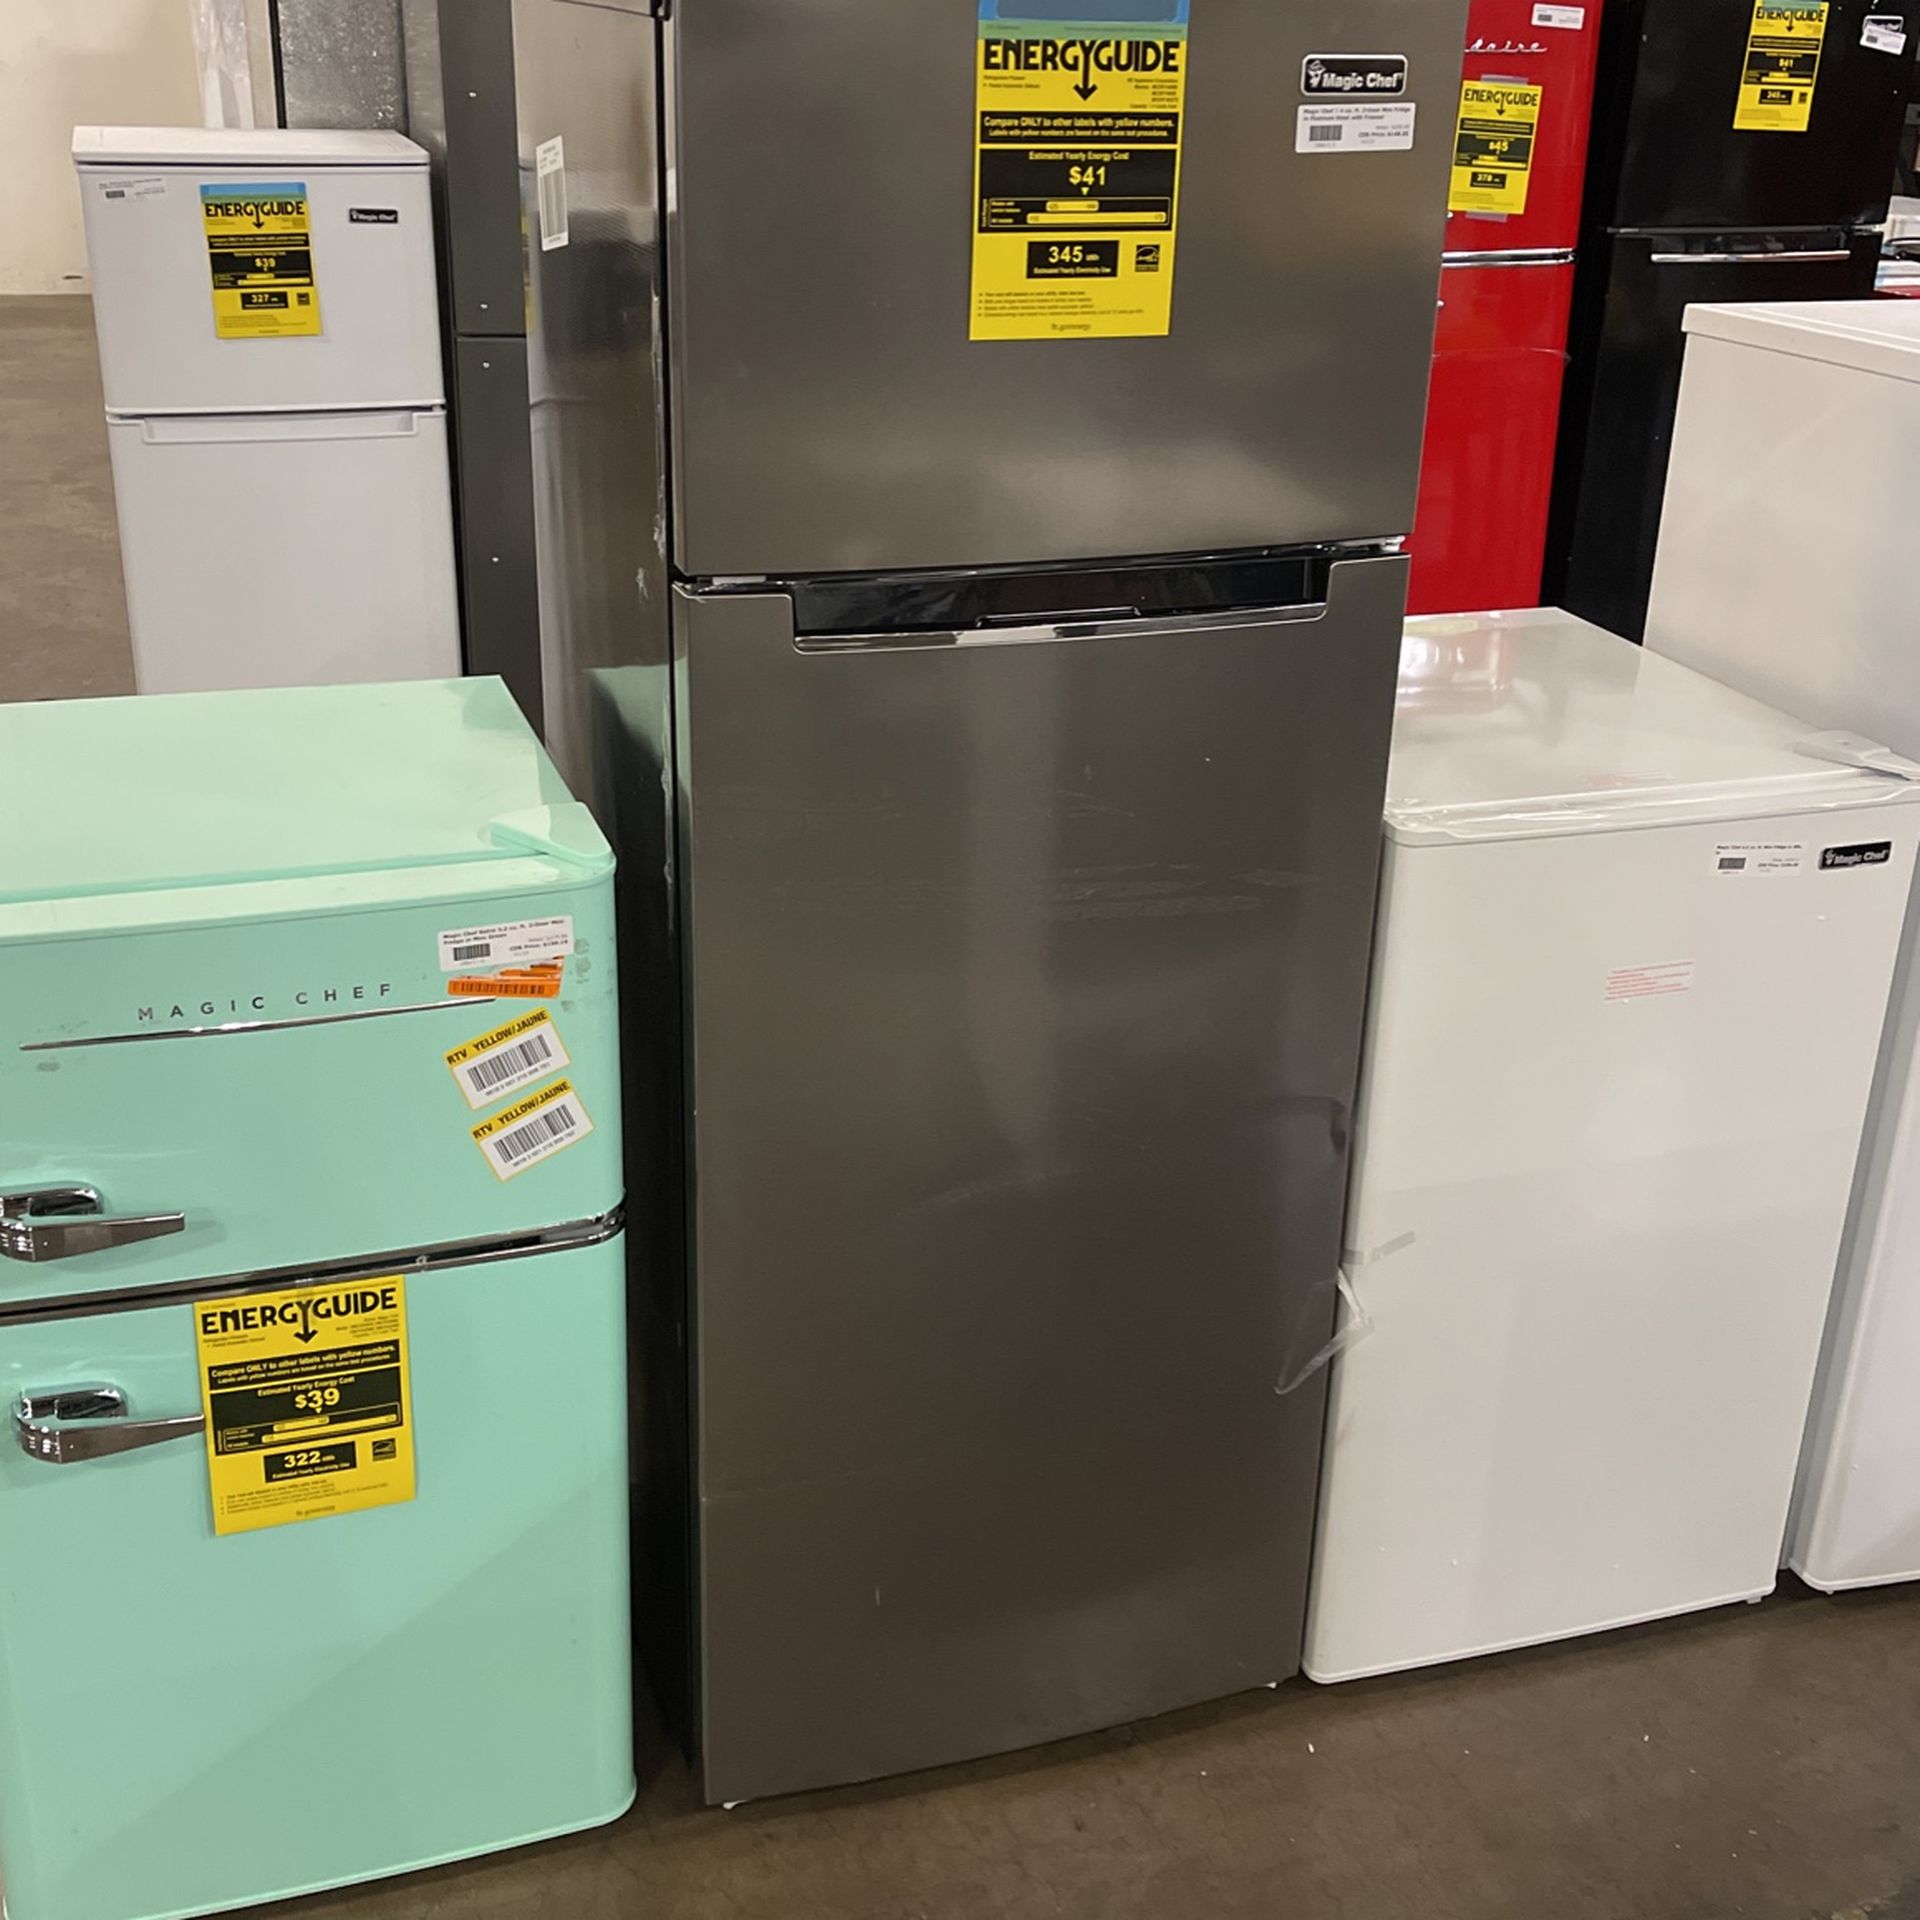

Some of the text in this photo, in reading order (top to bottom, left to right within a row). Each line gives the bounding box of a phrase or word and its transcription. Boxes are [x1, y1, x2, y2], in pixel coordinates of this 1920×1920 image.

[983, 38, 1180, 72] ENERGYGUIDE
[1322, 72, 1400, 91] Magic Chef
[1463, 88, 1539, 107] ENERGYGUIDE
[984, 116, 1175, 128] Compare ONLY to other labels with yellow numbers.
[1029, 152, 1130, 161] Estimated Yearly Energy Cost
[1068, 165, 1106, 186] $41
[205, 201, 305, 217] ENERGYGUIDE
[1048, 246, 1083, 263] 345
[1834, 851, 1886, 866] Magic Chef
[138, 983, 390, 1021] MAGIC CHEF
[446, 1011, 548, 1065] RTV YELLOW/JAUNE
[472, 1081, 570, 1140] RTV YELLOW/JAUNE
[201, 1287, 397, 1335] ENERGYGUIDE
[211, 1345, 395, 1379] Compare ONLY to other labels with yellow numbers.
[258, 1376, 355, 1397] Estimated Yearly Energy Cost
[295, 1387, 340, 1409] $39
[284, 1450, 321, 1468] 322
